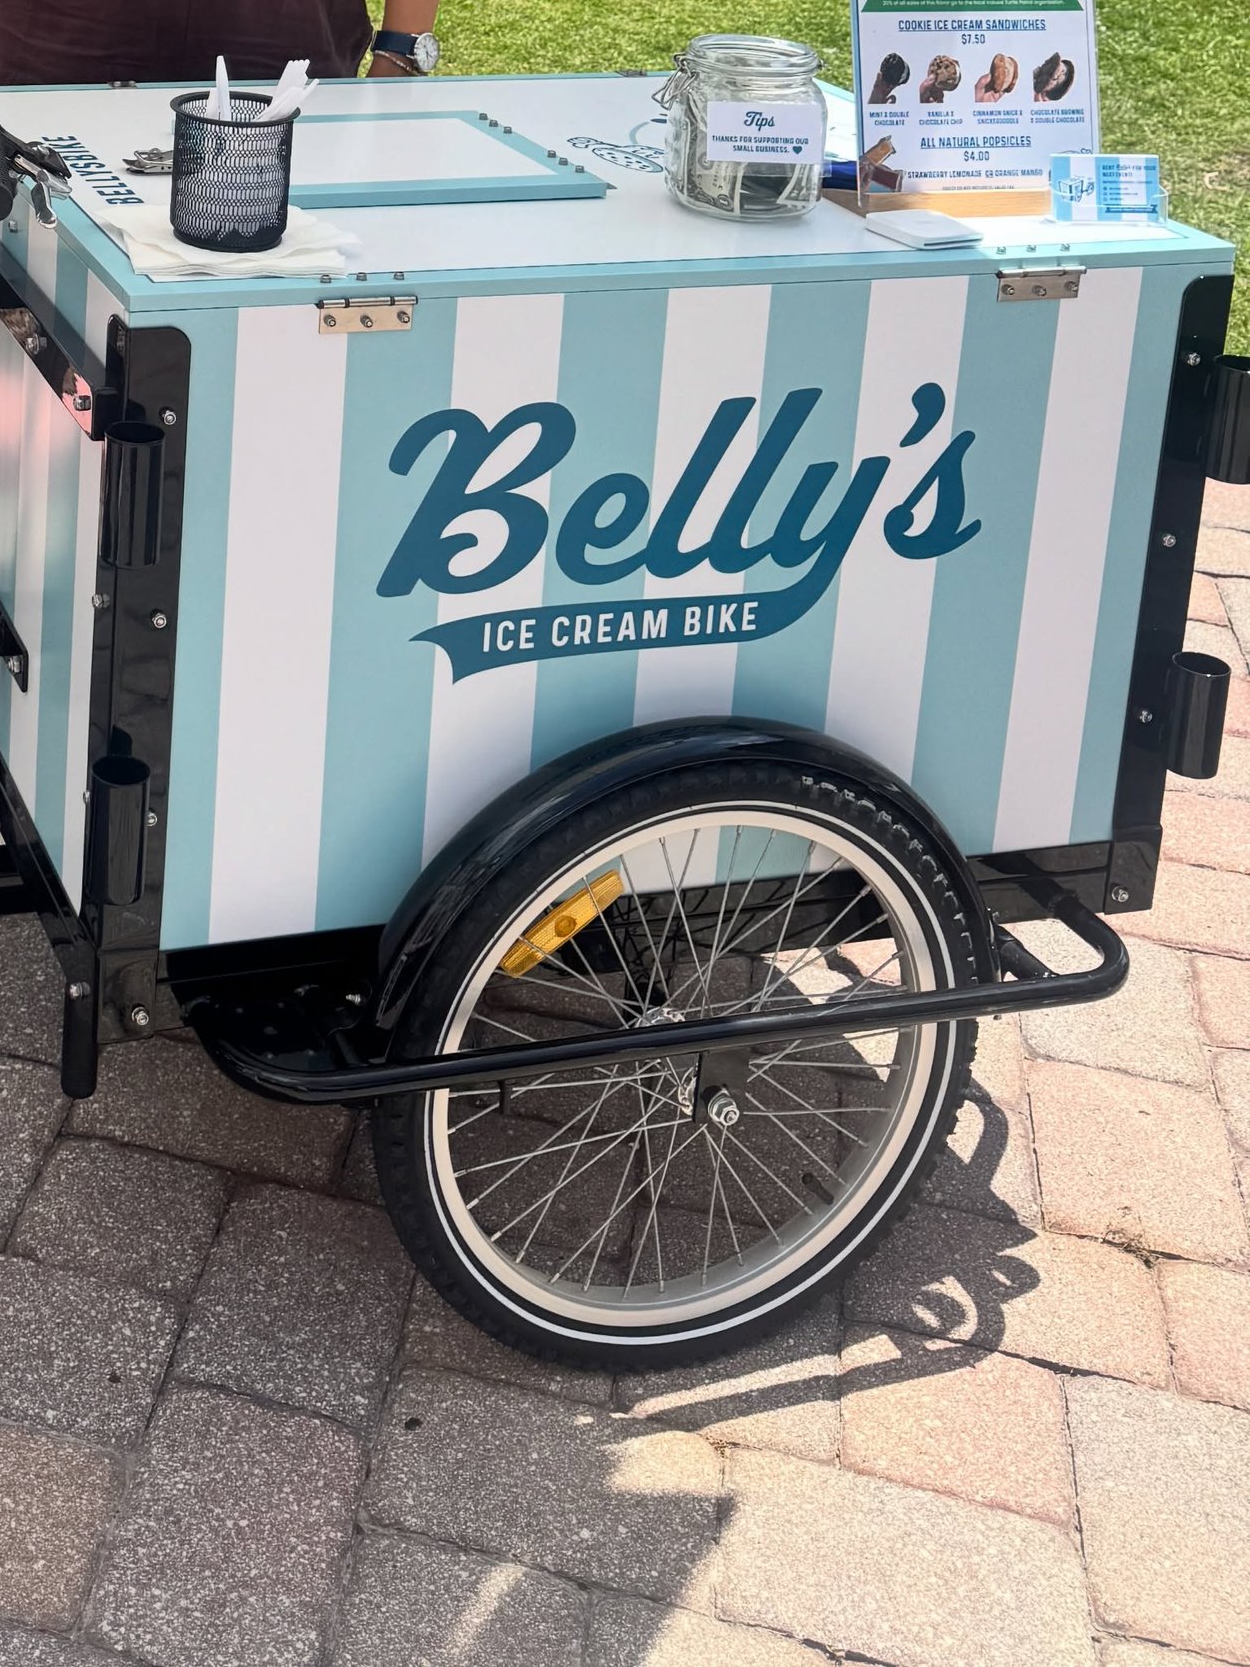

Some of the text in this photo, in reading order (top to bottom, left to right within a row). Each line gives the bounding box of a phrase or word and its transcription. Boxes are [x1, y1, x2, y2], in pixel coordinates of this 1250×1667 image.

[898, 20, 1046, 31] COOKIE ICE CREAM SANDWICHES
[961, 34, 986, 45] $7.50
[743, 111, 775, 132] Tips
[753, 136, 794, 144] SUPPORTING
[795, 137, 809, 145] OUR
[920, 136, 1032, 148] ALL NATURAL POPSICLES
[964, 151, 990, 161] $4.00
[42, 135, 145, 204] BELLYSBIKE
[907, 171, 948, 179] STRAWBERRY
[950, 170, 982, 178] LEMONADE
[376, 381, 981, 644] Belly's
[483, 601, 759, 653] ICE CREAM BIKE
